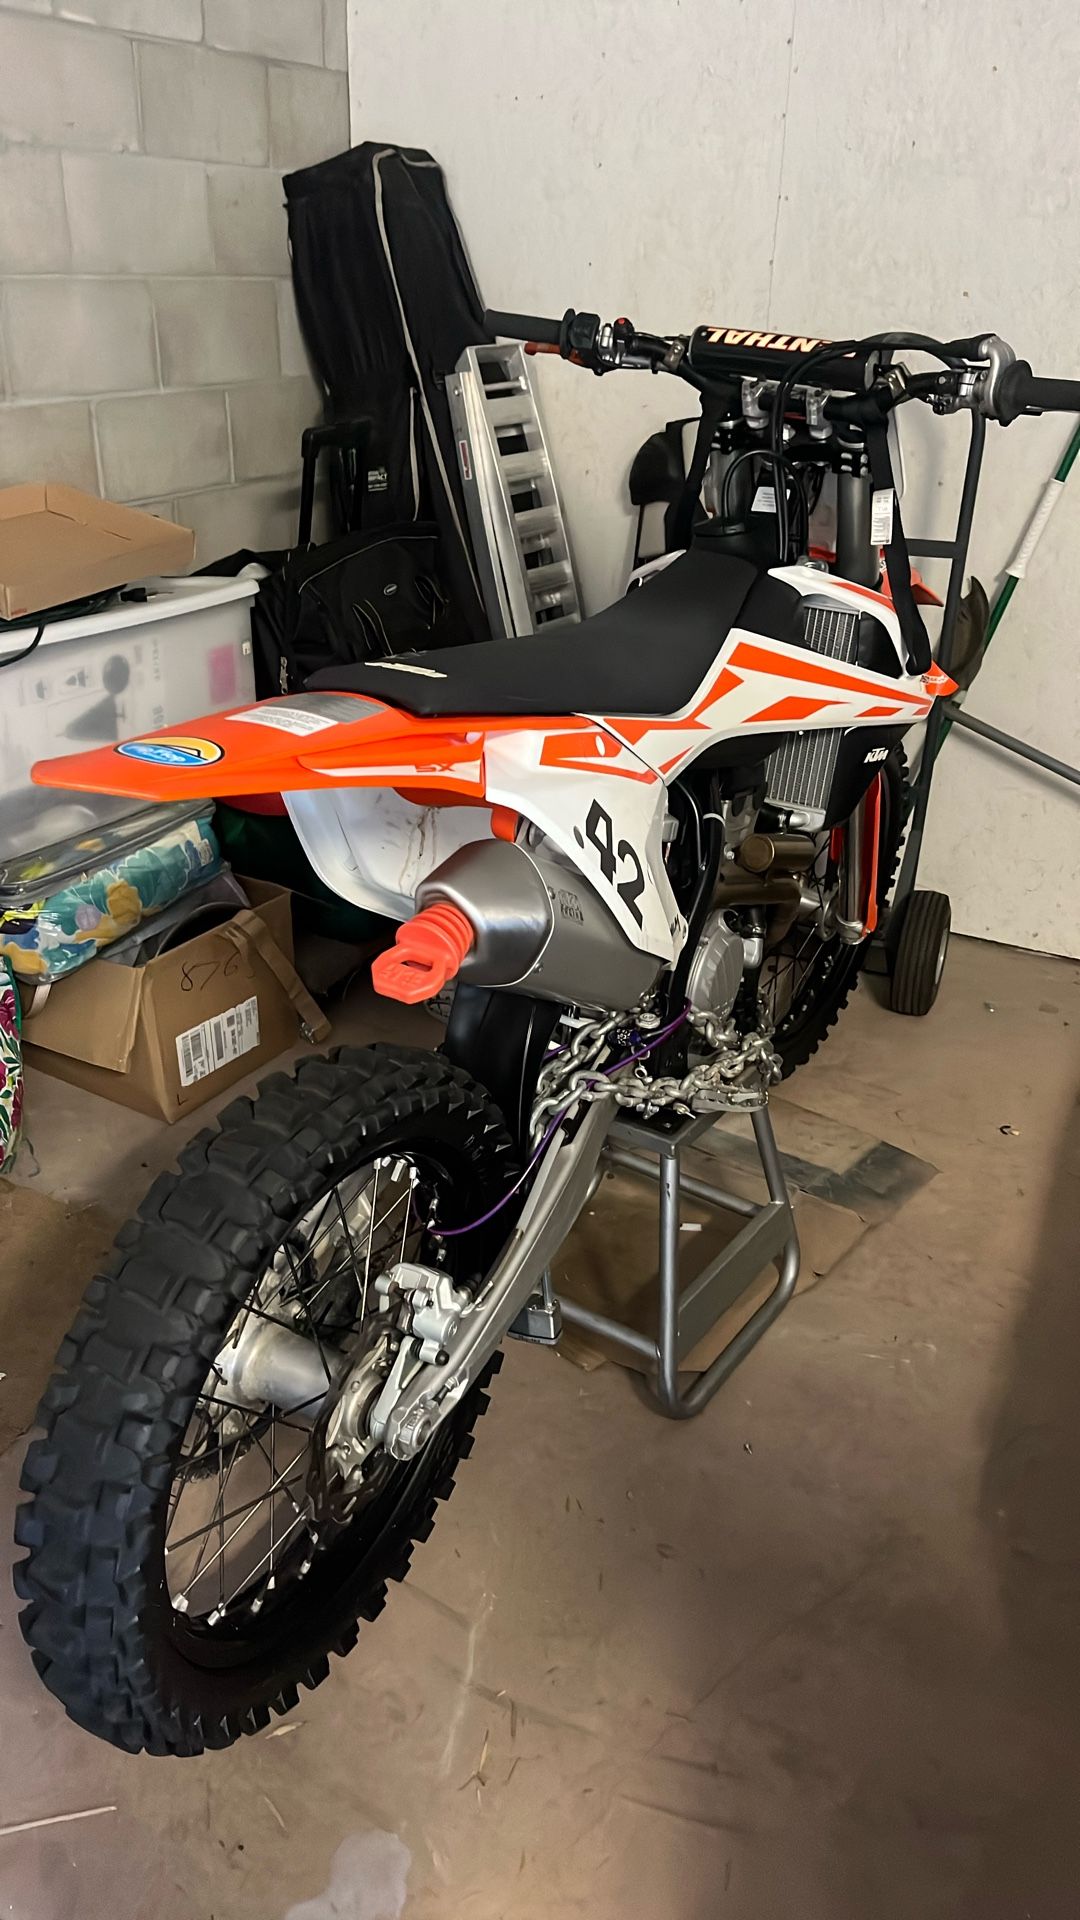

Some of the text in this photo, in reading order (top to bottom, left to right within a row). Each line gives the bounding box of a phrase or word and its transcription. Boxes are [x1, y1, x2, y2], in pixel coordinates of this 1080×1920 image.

[863, 747, 889, 763] KTM
[415, 763, 455, 773] SX
[586, 798, 646, 932] 42
